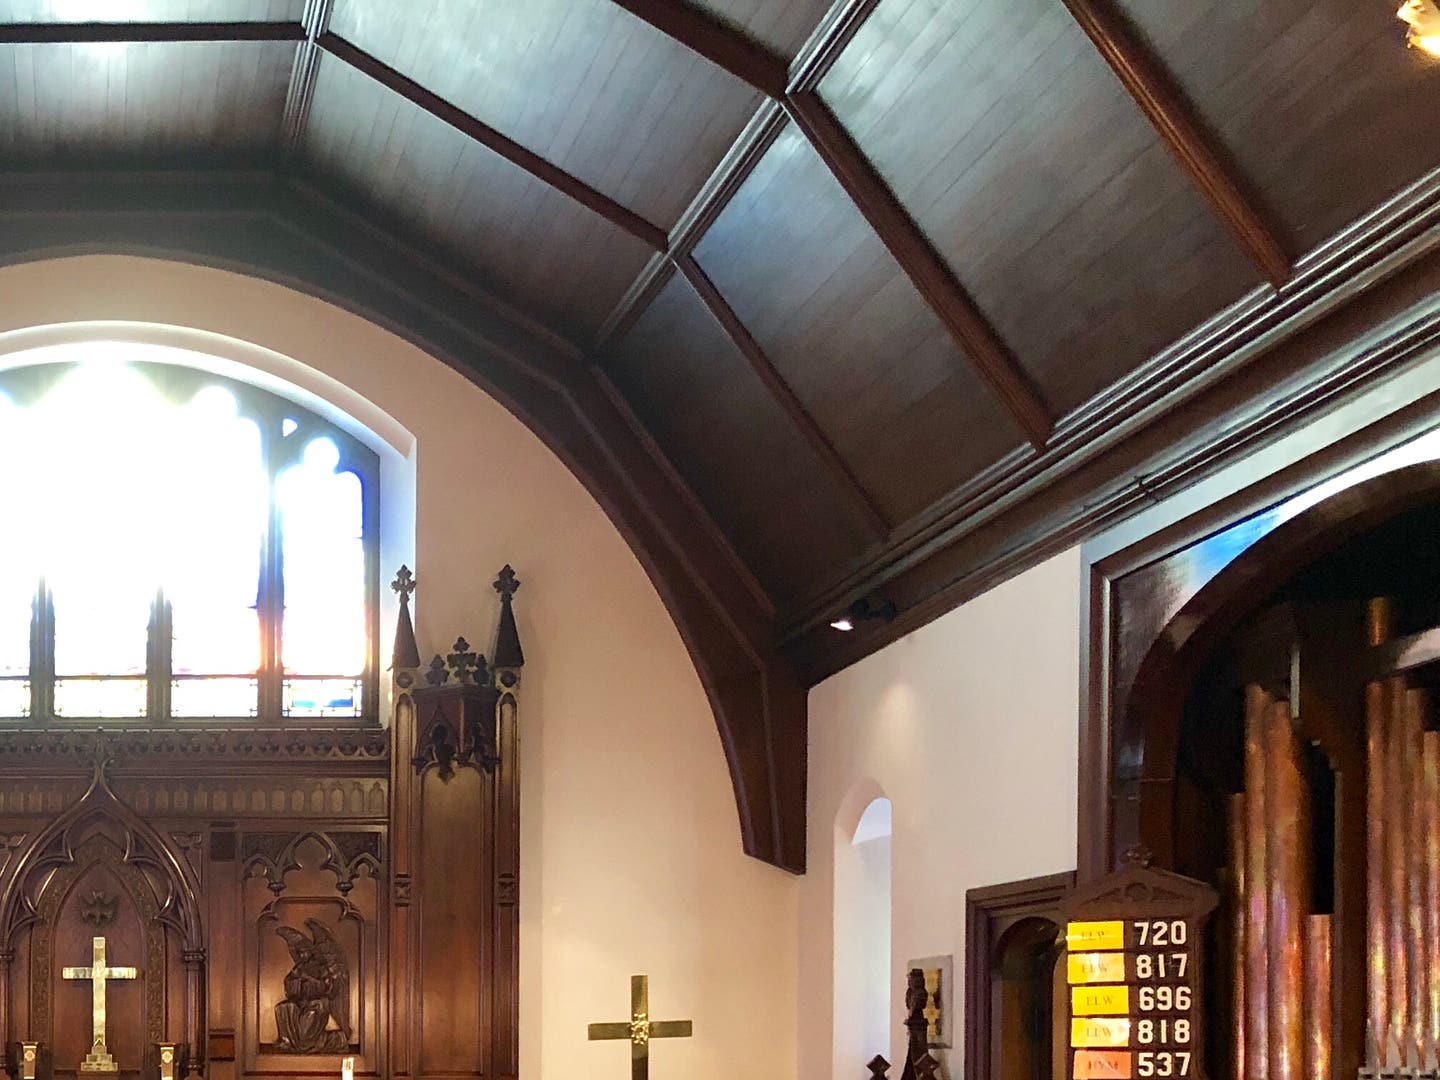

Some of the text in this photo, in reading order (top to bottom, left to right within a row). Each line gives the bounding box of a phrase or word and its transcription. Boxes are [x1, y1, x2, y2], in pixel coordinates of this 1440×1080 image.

[1134, 920, 1187, 946] 720
[1081, 953, 1188, 979] ELW 817
[1086, 986, 1192, 1011] ELW 696
[1137, 1019, 1190, 1044] 818
[1138, 1052, 1191, 1077] 537
